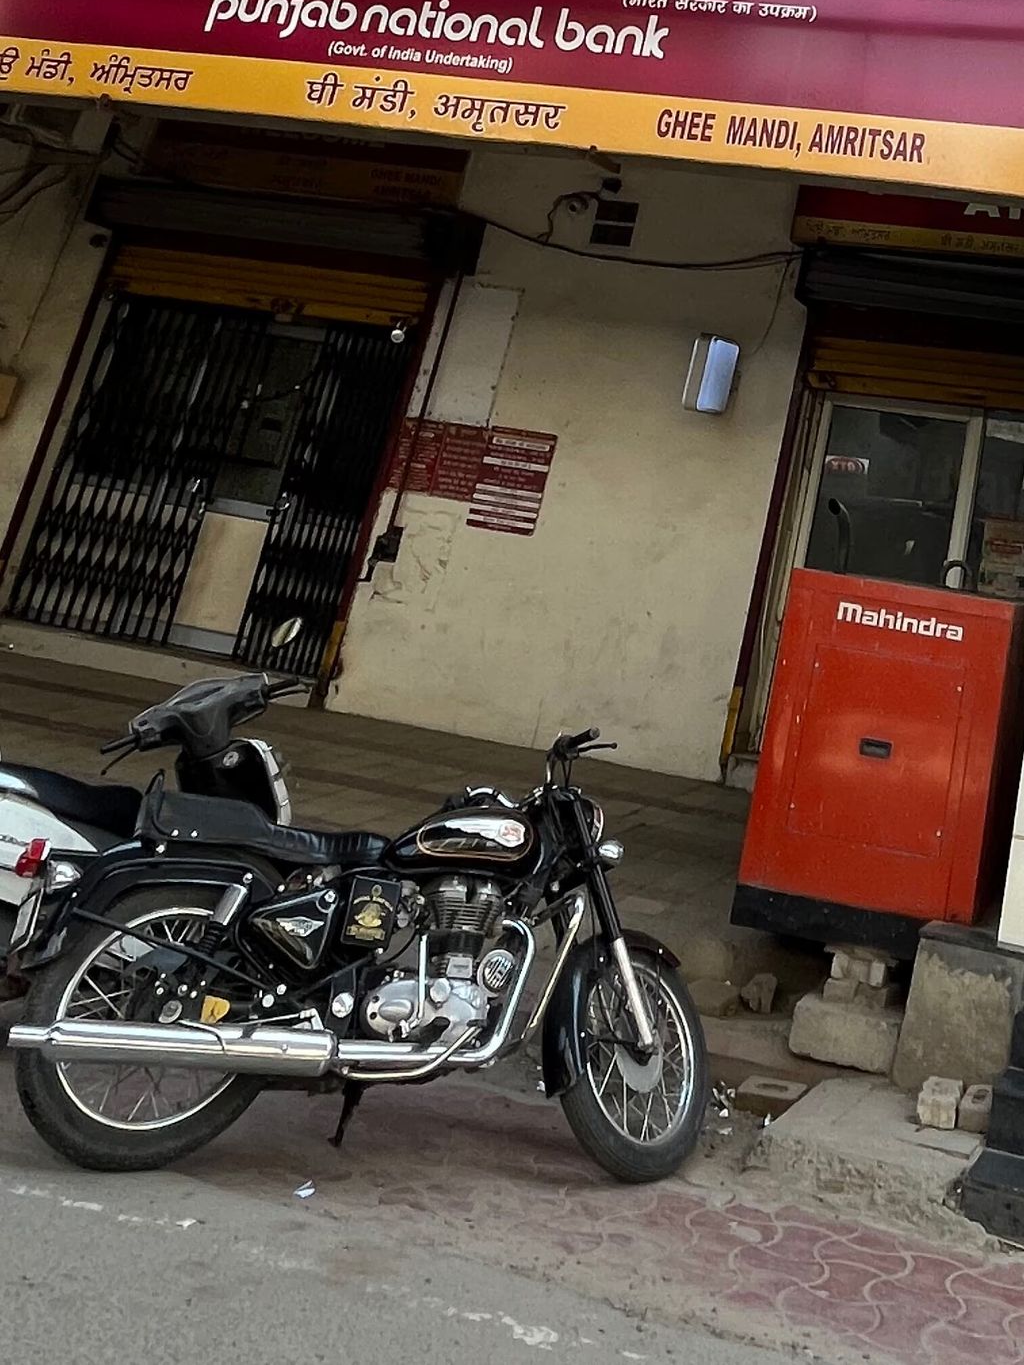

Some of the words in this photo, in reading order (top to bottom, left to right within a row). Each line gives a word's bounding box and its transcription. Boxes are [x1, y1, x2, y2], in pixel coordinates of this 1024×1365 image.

[732, 0, 754, 15] का
[555, 8, 670, 59] bank
[328, 40, 367, 58] (Govt.
[372, 45, 387, 59] of
[388, 46, 421, 62] India
[425, 50, 513, 74] Undertaking)
[306, 72, 344, 106] घी
[352, 75, 417, 119] मंडी,
[433, 93, 566, 132] अमृतसर
[656, 108, 716, 142] GHEE
[726, 114, 802, 160] MANDI,
[808, 122, 925, 164] AMRITSAR
[837, 601, 963, 641] Mahindra
